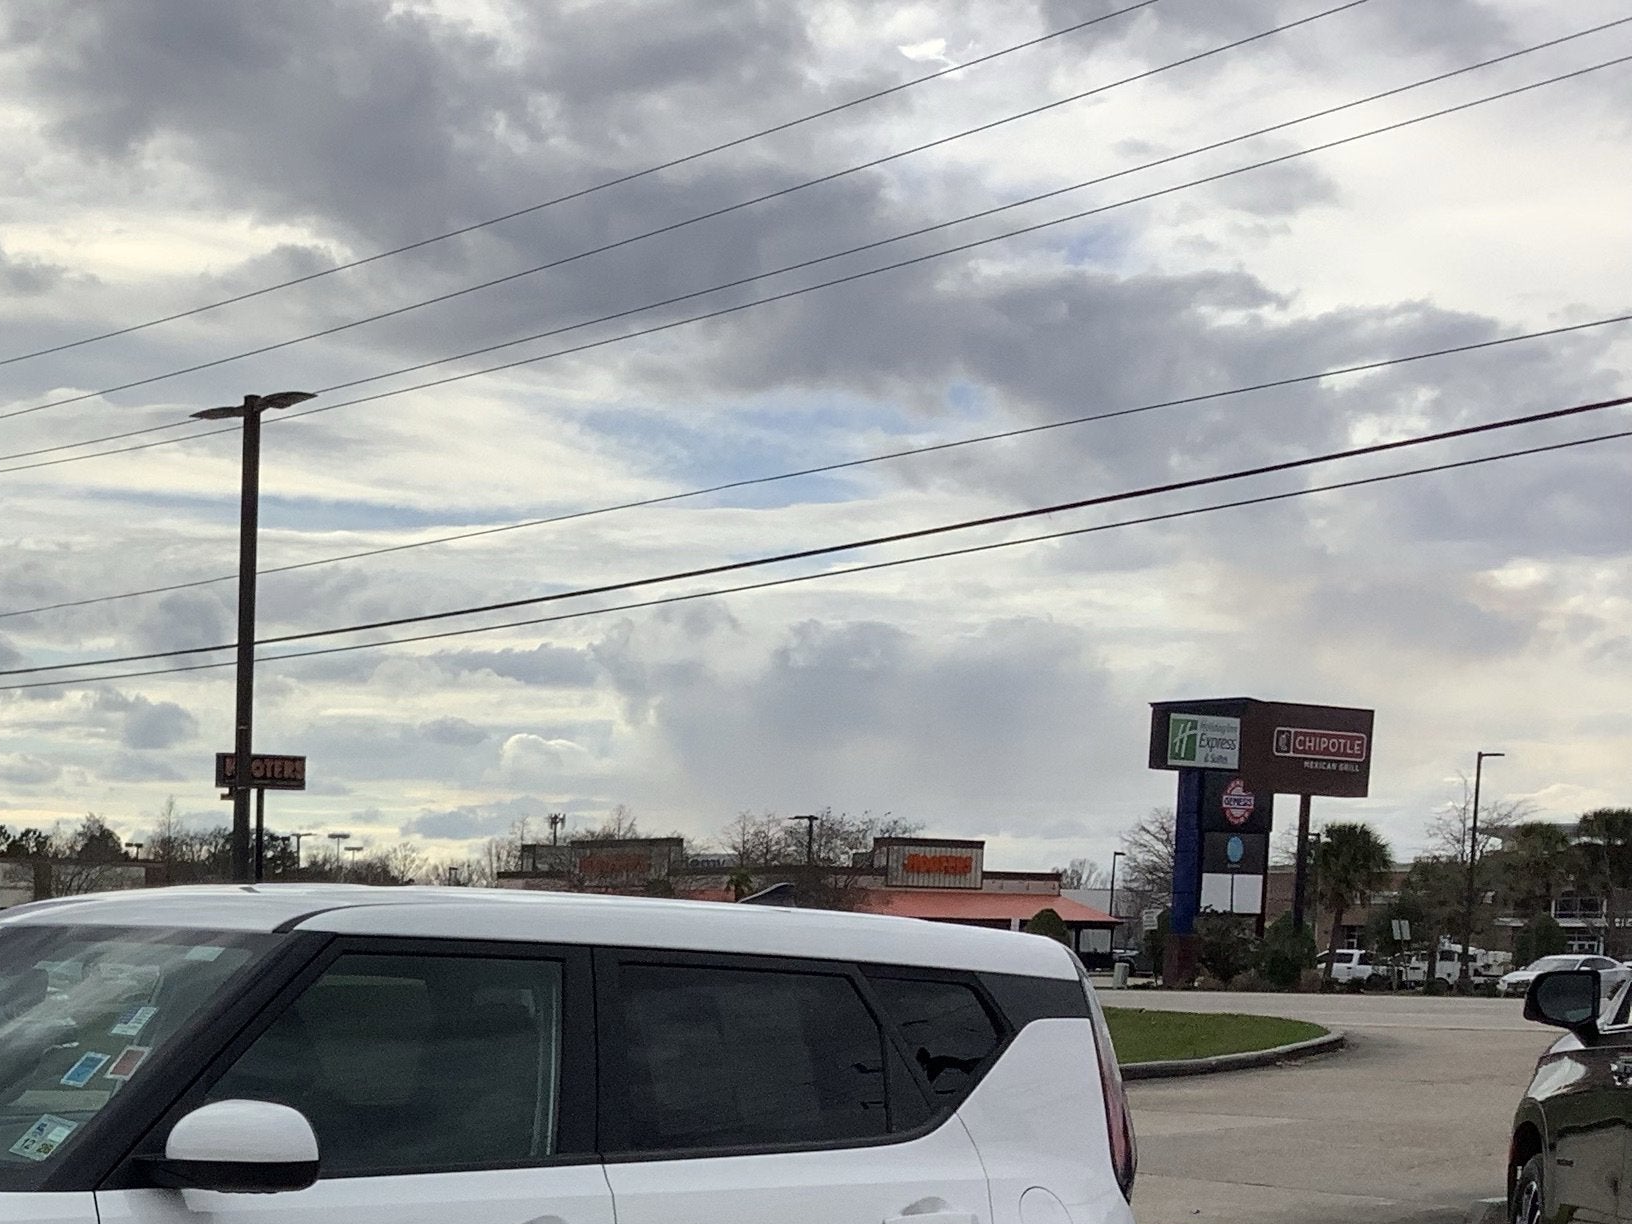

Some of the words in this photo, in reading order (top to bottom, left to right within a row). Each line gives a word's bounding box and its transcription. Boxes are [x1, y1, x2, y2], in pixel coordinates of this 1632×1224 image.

[1199, 732, 1237, 752] Express
[1295, 735, 1362, 754] CHIPOTLE
[225, 756, 305, 780] HOTERS
[1304, 760, 1337, 771] MEXICAN
[1338, 762, 1360, 772] GRILL
